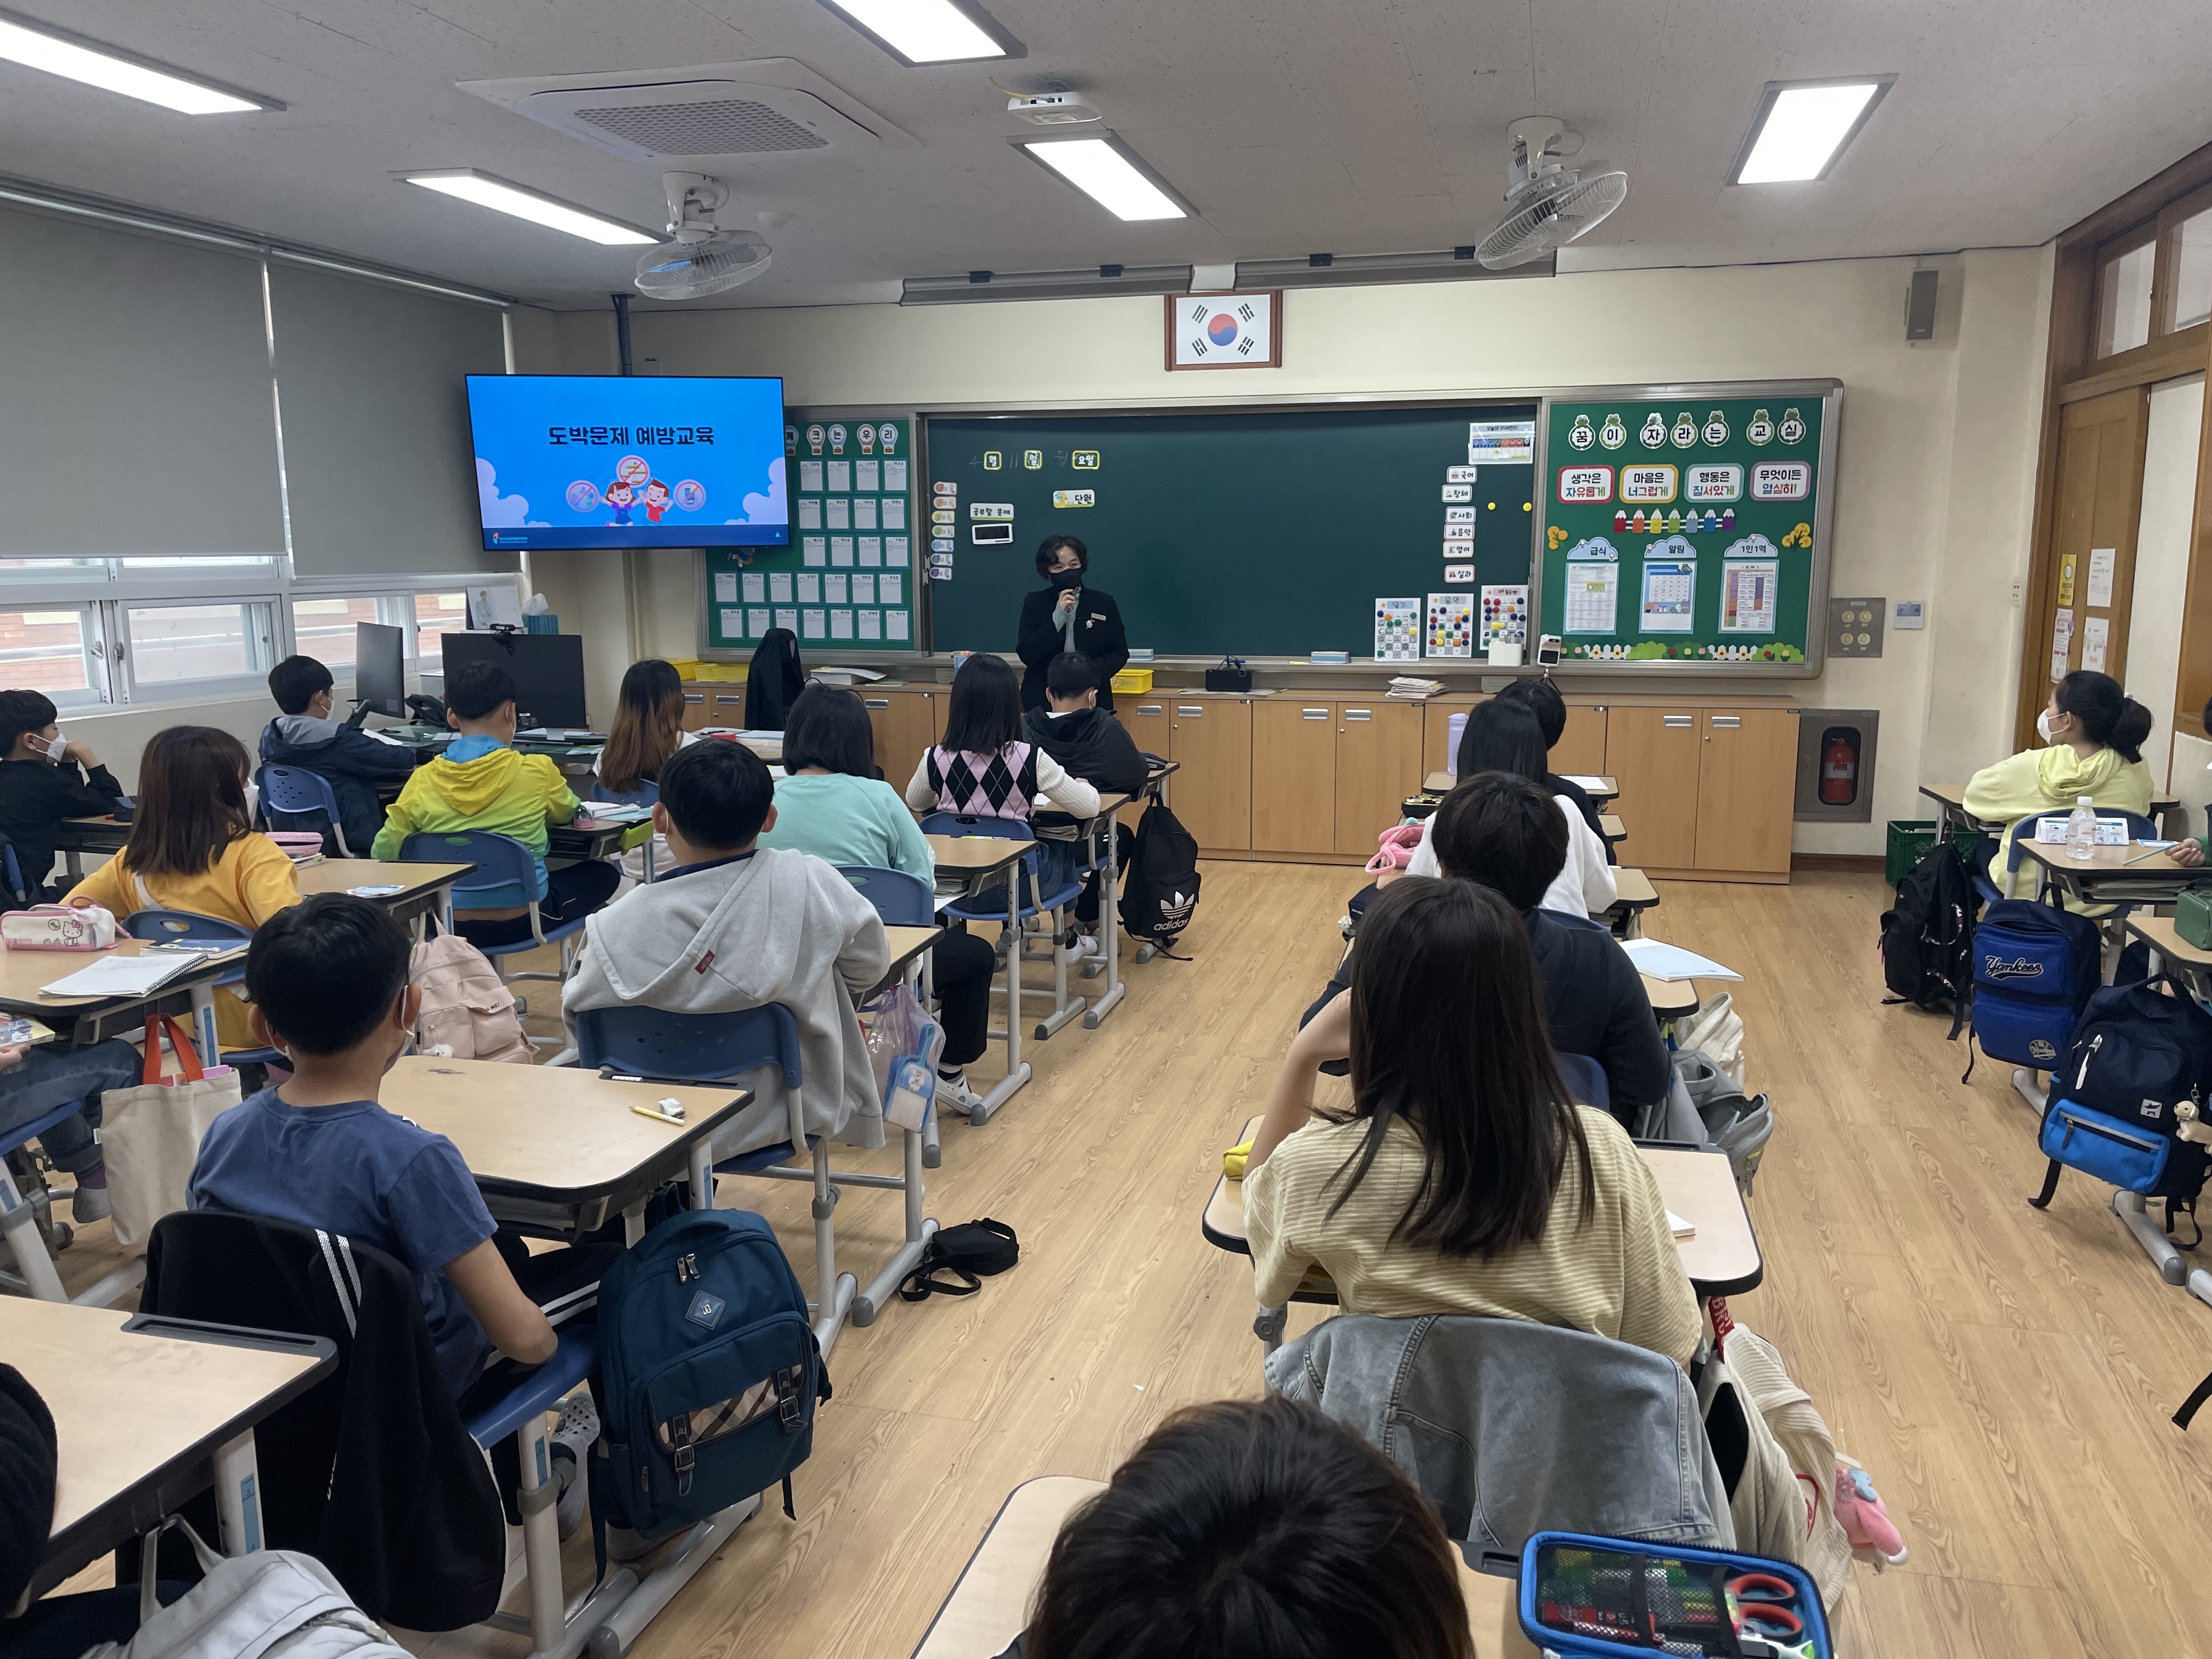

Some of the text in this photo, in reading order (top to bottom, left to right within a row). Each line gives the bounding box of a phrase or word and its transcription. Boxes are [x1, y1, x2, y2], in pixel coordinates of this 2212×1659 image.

[549, 426, 714, 445] 도박문제 예방교육
[1647, 427, 1722, 441] 자라는
[989, 455, 997, 467] 월
[1077, 455, 1094, 466] 요일
[1461, 471, 1474, 479] 국어
[1571, 473, 1601, 484] 생각은
[1634, 472, 1664, 484] 마음은
[1700, 471, 1730, 483] 행동은
[1760, 470, 1802, 481] 무엇이든
[1566, 486, 1605, 497] 자유롭게
[1628, 486, 1668, 497] 너그럽게
[1693, 485, 1735, 496] 질서있게
[1762, 483, 1797, 494] 열심히!
[1075, 494, 1092, 504] 단원
[973, 507, 1011, 516] 공부할 문제
[1458, 528, 1471, 537] 음악
[1590, 546, 1606, 556] 급식
[1669, 545, 1684, 554] 알림
[1458, 571, 1471, 579] 실과
[1153, 918, 1189, 931] adidas
[1985, 955, 2044, 981] Yankees
